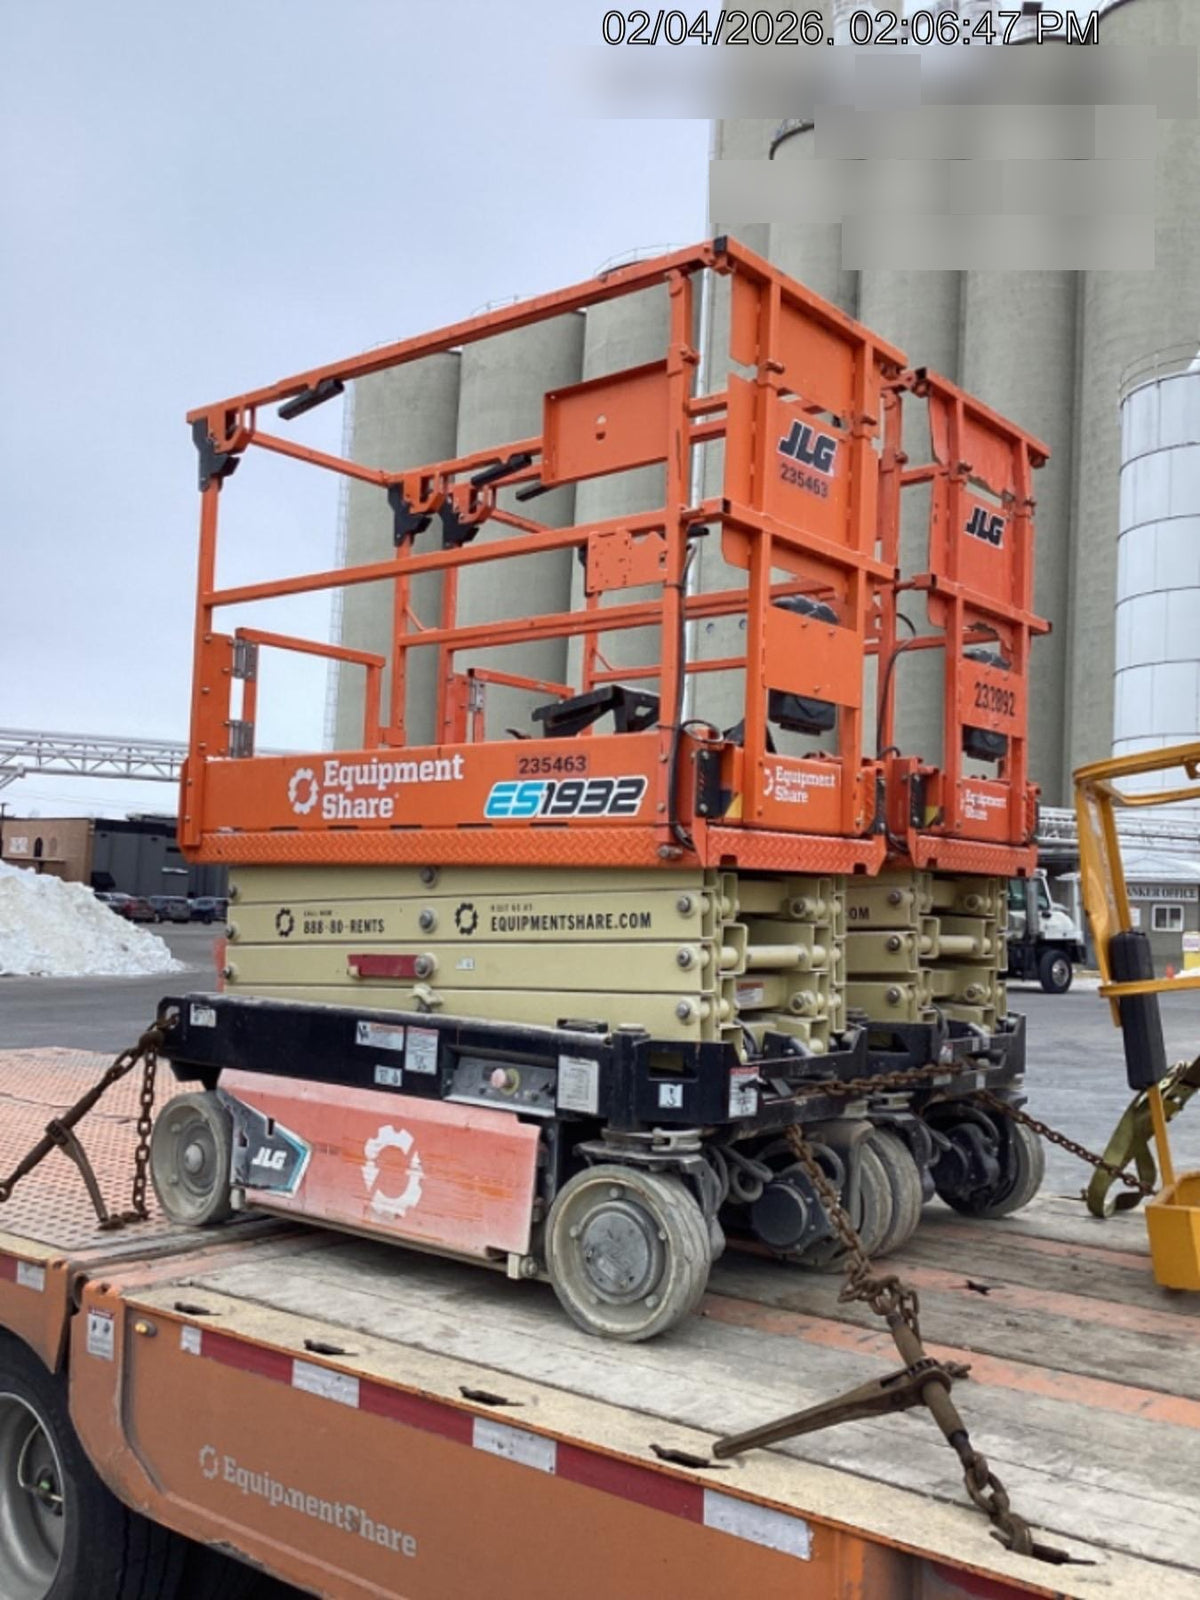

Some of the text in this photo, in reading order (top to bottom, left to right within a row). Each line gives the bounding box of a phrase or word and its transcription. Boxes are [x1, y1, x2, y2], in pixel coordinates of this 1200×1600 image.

[779, 420, 836, 476] JLG
[780, 463, 829, 498] 235463
[965, 506, 1004, 549] JLG
[323, 753, 464, 790] Equipment
[518, 755, 587, 775] 235463
[776, 765, 836, 788] Equipment
[322, 792, 394, 820] Share
[485, 775, 647, 819] ES1932
[775, 785, 808, 803] Share
[491, 912, 651, 932] EQUIPMENTSHARE.COM
[252, 1146, 287, 1170] JLG
